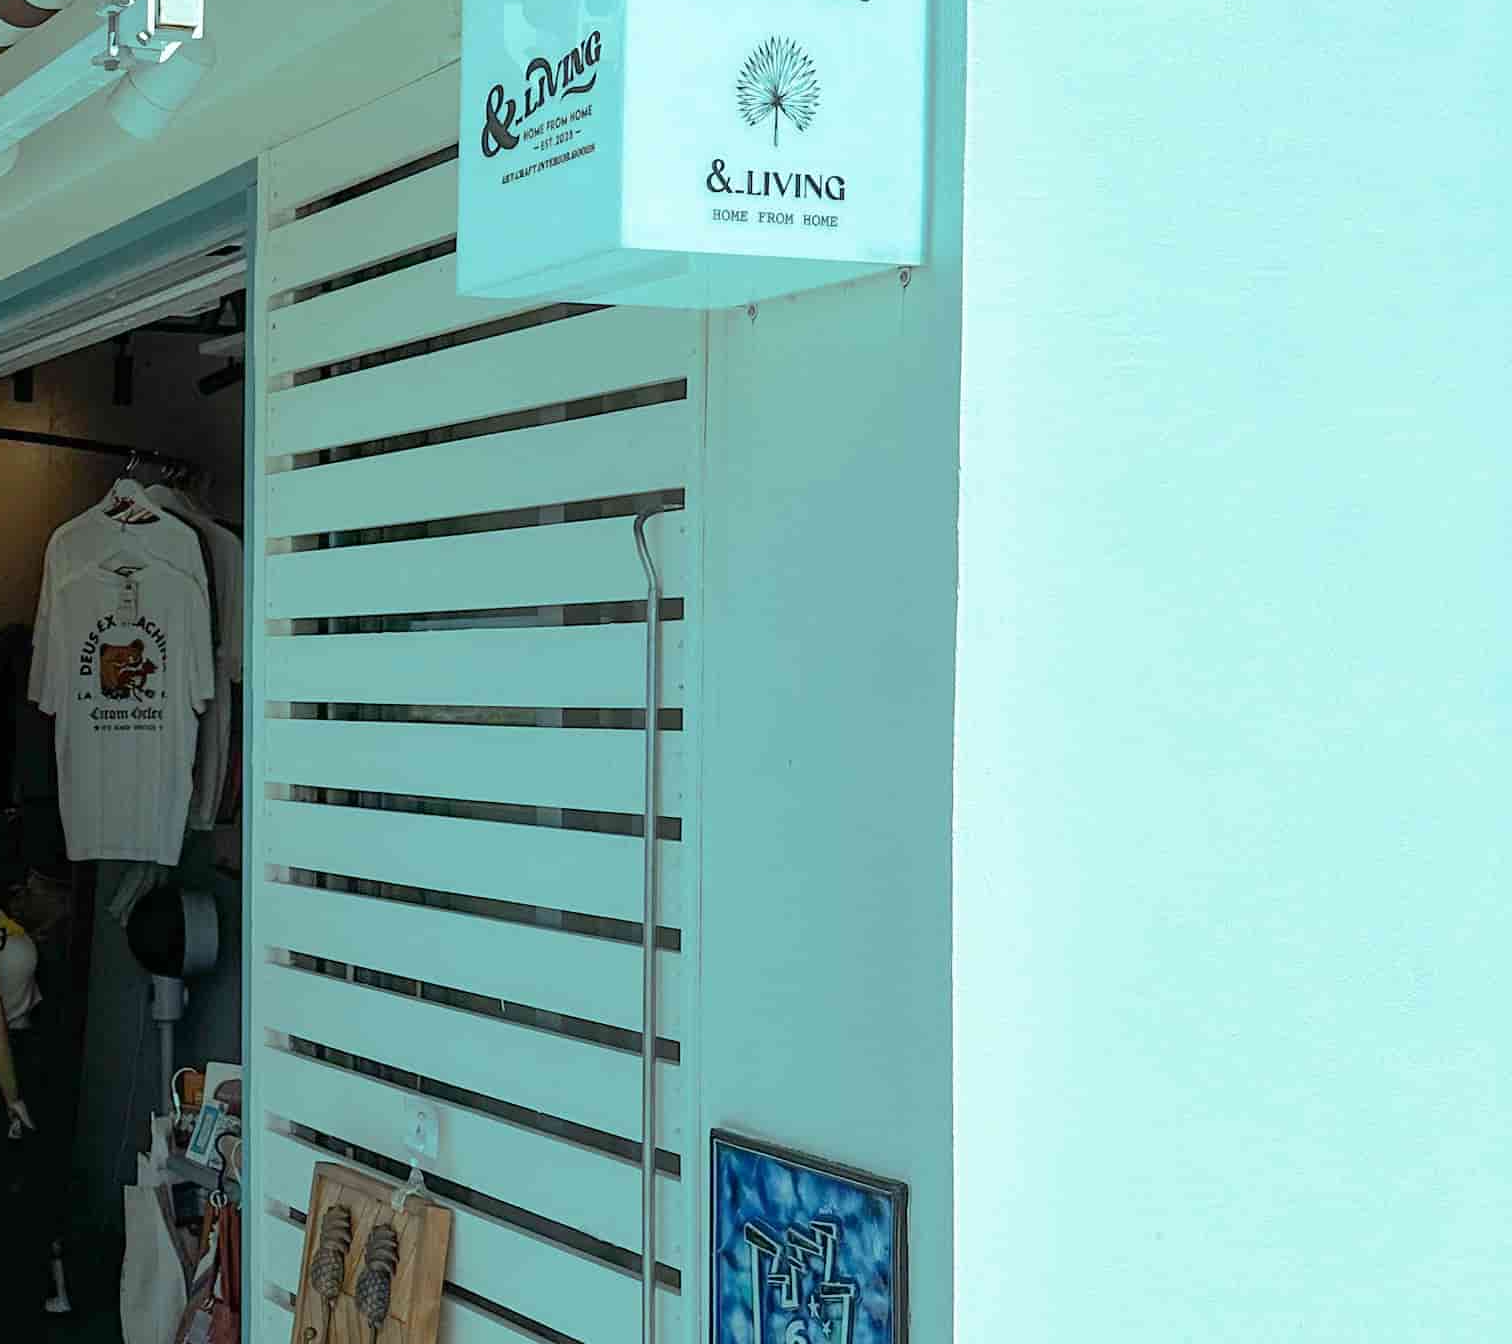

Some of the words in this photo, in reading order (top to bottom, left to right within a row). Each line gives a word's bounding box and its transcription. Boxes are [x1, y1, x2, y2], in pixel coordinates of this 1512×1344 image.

[712, 209, 749, 223] HOME
[758, 211, 795, 225] FROM
[802, 214, 839, 228] HOME
[79, 631, 100, 676] DEUS
[96, 615, 117, 633] EX
